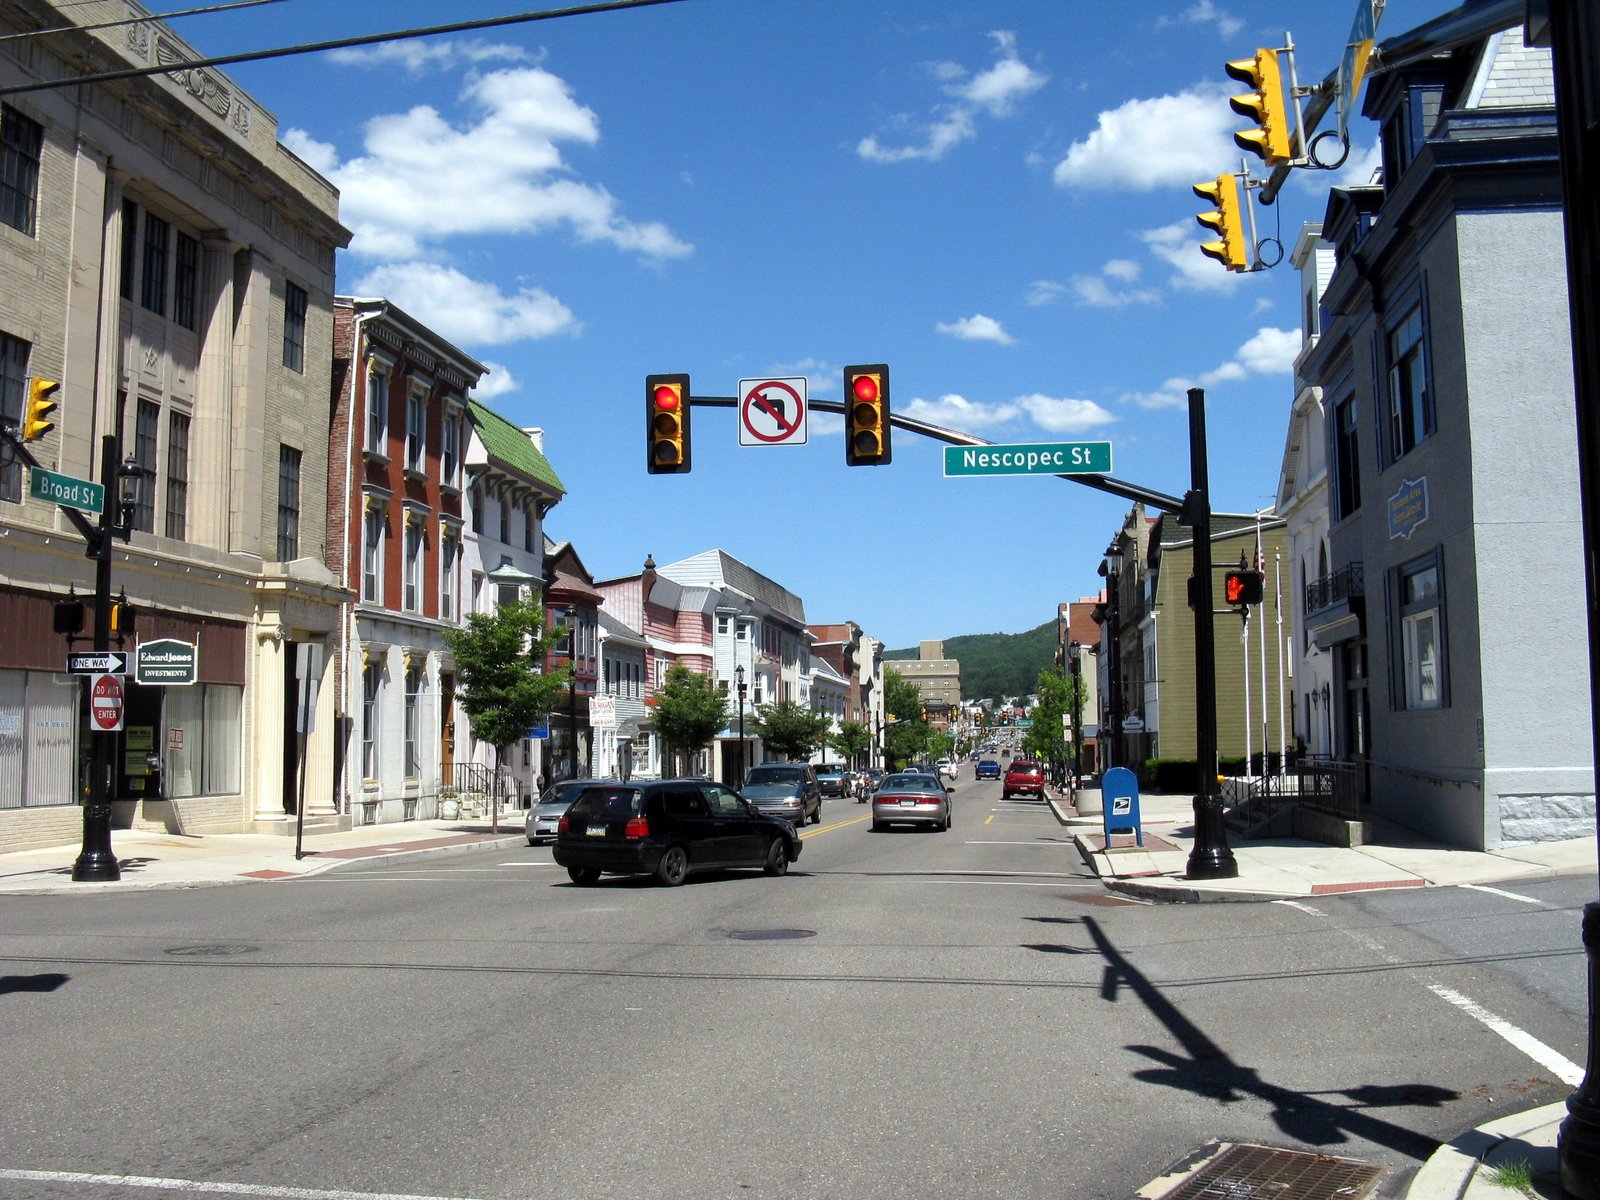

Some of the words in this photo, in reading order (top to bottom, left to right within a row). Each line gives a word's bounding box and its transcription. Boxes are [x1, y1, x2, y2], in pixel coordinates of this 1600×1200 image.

[963, 450, 1064, 470] Nescopec
[1071, 447, 1092, 465] St
[41, 477, 79, 502] Broad
[82, 487, 95, 506] St
[73, 657, 89, 669] ONE
[92, 658, 109, 668] WAY
[96, 685, 105, 695] DO
[108, 685, 119, 695] NOT
[98, 709, 117, 719] ENTER
